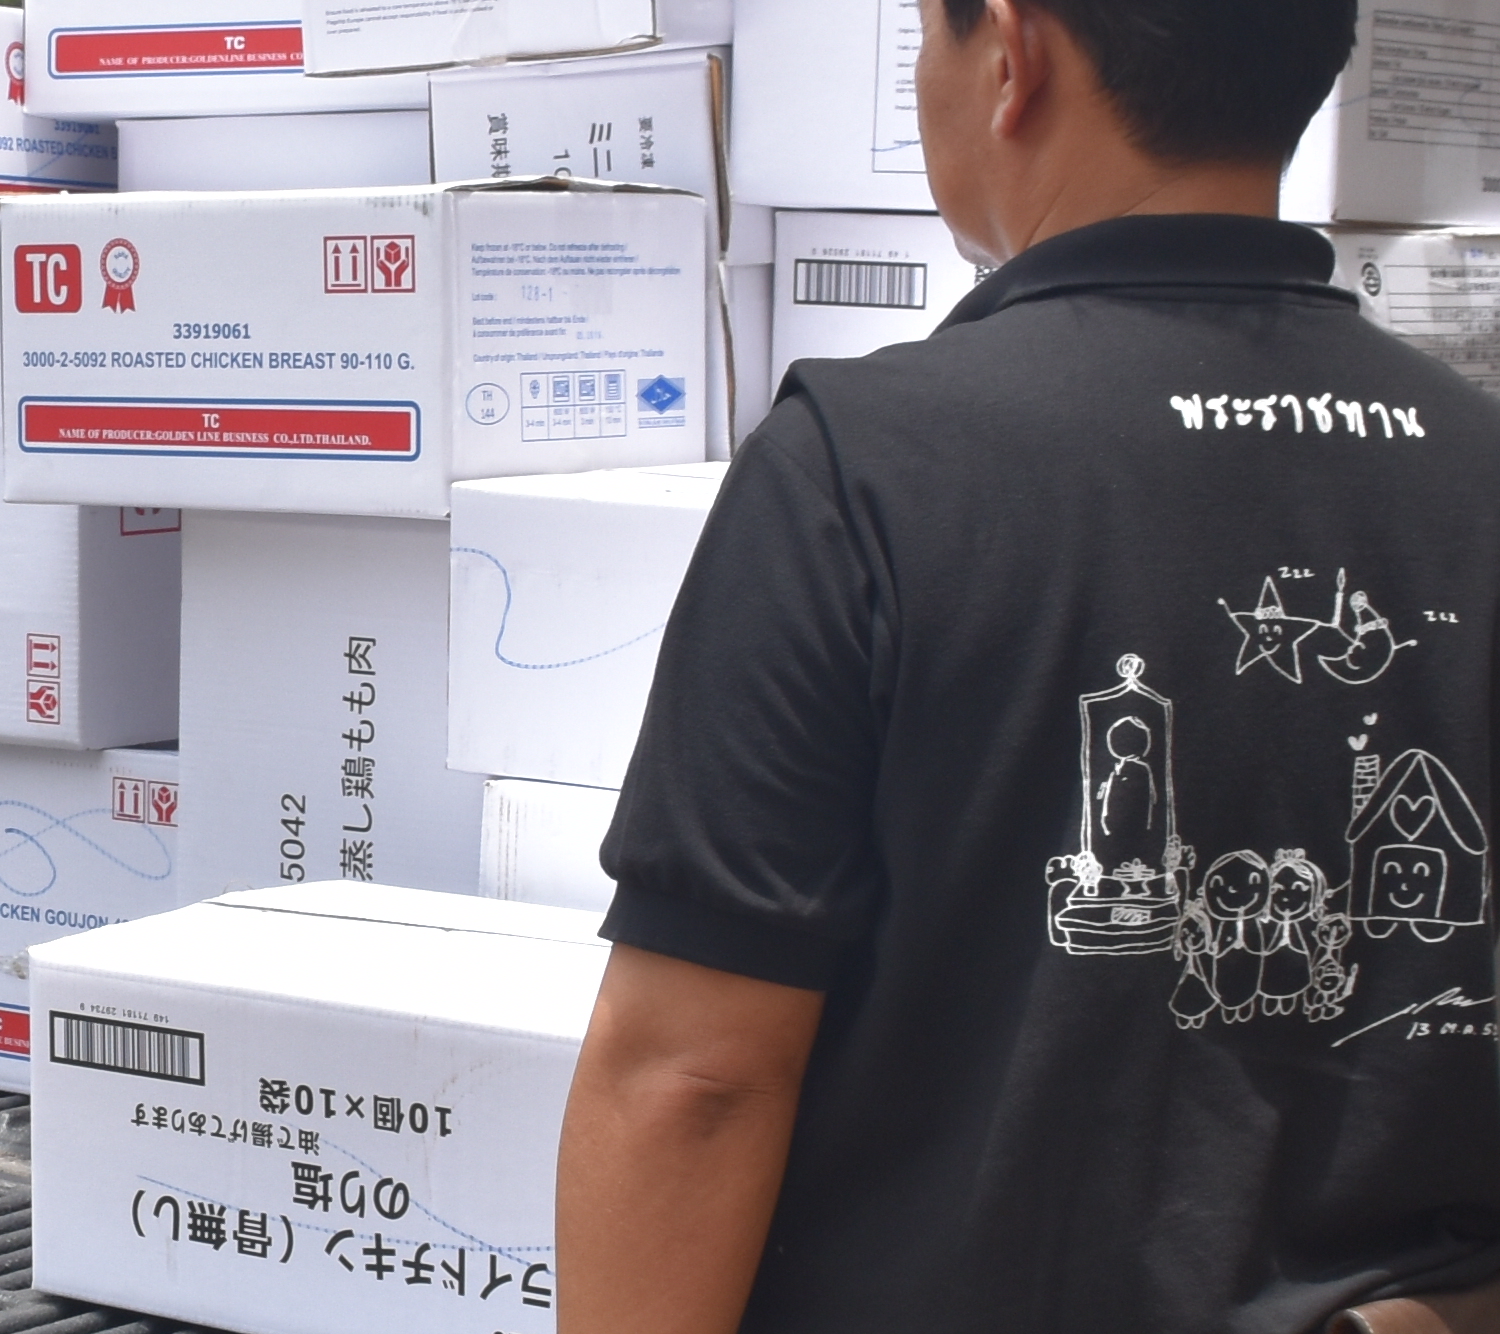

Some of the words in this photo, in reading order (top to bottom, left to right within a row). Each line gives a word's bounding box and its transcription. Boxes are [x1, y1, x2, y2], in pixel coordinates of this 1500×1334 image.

[224, 36, 246, 50] TC
[99, 57, 124, 66] NAME
[126, 56, 139, 65] OF
[246, 52, 287, 62] BUSINESS
[16, 137, 64, 156] ROASTED
[66, 142, 108, 160] CHICKEN
[26, 253, 67, 305] TC
[172, 323, 251, 340] 33919061
[22, 351, 107, 369] 3000-2-5092
[110, 351, 186, 370] ROASTED
[190, 352, 263, 370] CHICKEN
[268, 352, 336, 371] BREAST
[340, 352, 393, 371] 90-110
[397, 353, 415, 371] G.
[481, 390, 493, 401] TH
[202, 413, 220, 429] TC
[1170, 393, 1425, 439] พระราชทาน
[58, 428, 86, 439] NAME
[87, 429, 100, 439] OF
[197, 431, 220, 442] LINE
[222, 432, 270, 443] BUSINESS
[280, 793, 307, 883] 5042
[79, 1002, 86, 1011] 9
[90, 1004, 117, 1016] 29734
[122, 1008, 149, 1021] 71181
[153, 1013, 169, 1024] 149
[257, 1077, 454, 1138] 10個×10袋
[131, 1101, 321, 1156] 油で揚げてあります
[291, 1160, 410, 1220] のり塩
